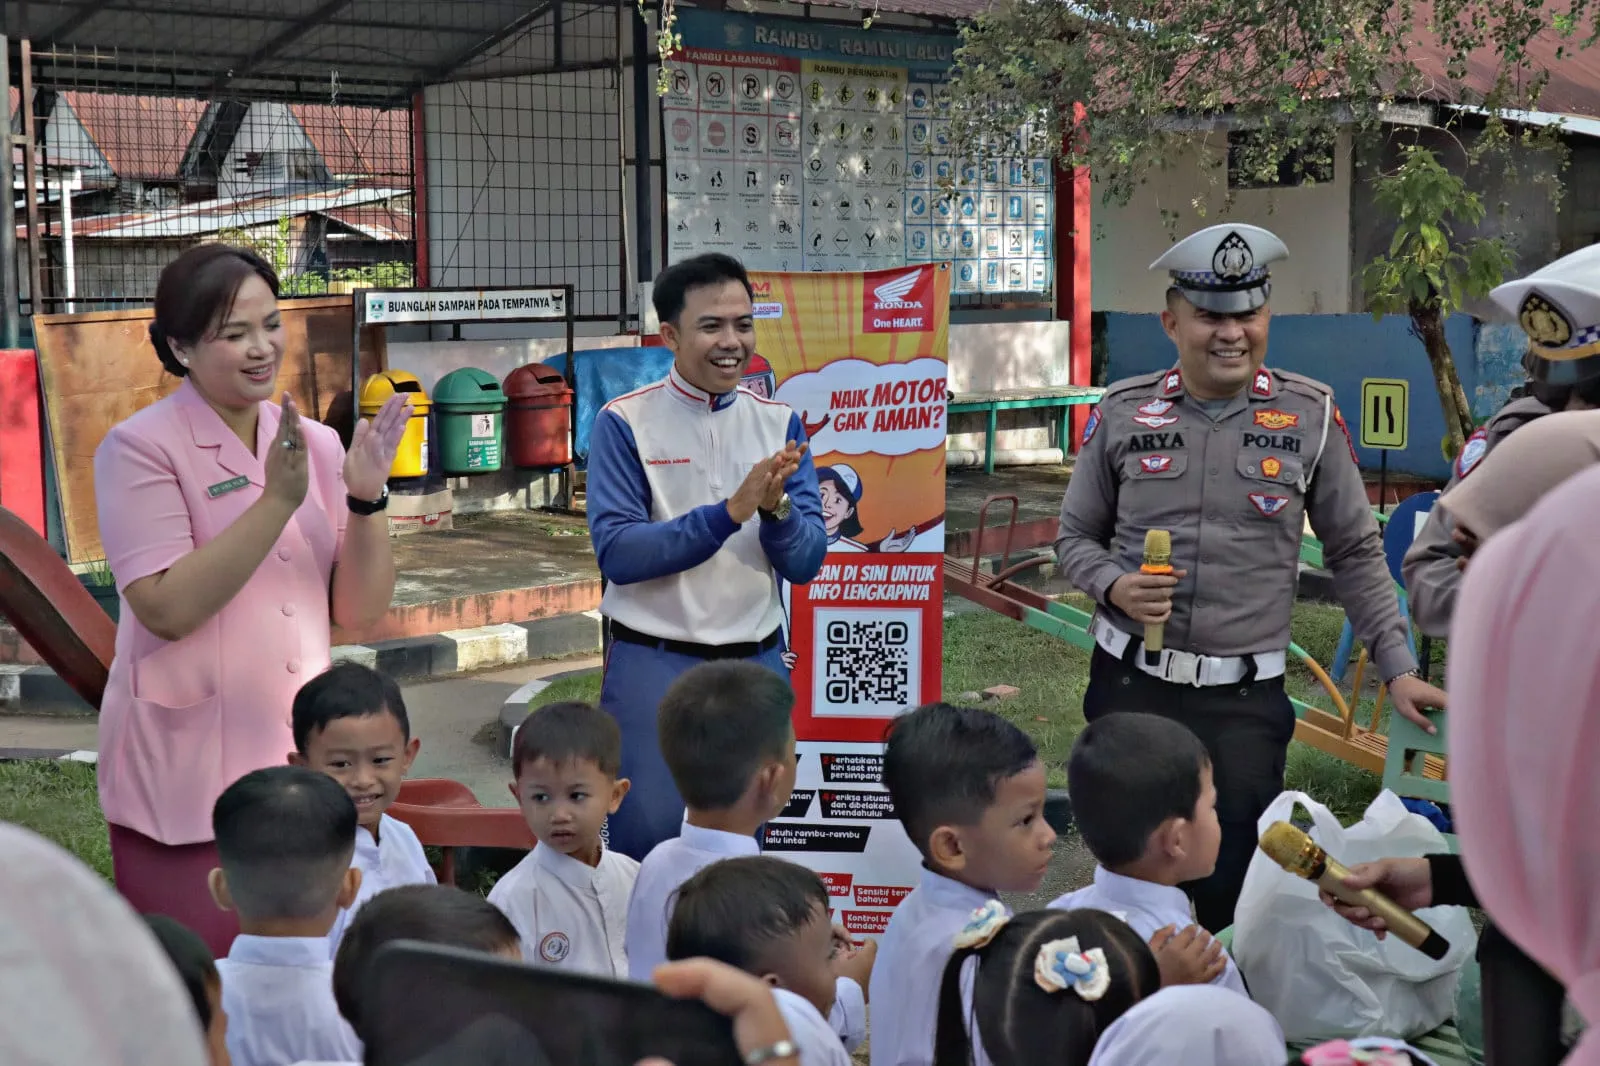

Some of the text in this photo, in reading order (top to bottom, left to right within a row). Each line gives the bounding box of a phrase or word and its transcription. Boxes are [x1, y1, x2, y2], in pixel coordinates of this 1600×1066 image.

[754, 25, 821, 51] RAMBU
[814, 64, 845, 75] RAMBU
[388, 297, 550, 313] BUANGLAH SAMPAH PADA TEMPATNYA
[873, 302, 923, 310] HONDA
[873, 319, 891, 328] One
[830, 378, 947, 410] NAIK MOTOR
[833, 405, 945, 433] GAK AMAN?
[1129, 432, 1185, 450] ARYA
[1243, 432, 1301, 453] POLRI
[842, 565, 859, 581] DI
[860, 565, 888, 582] SINI
[890, 565, 937, 582] UNTUK
[808, 584, 930, 601] INFO LENGKAPNYA
[830, 763, 845, 771] kiri
[862, 794, 890, 802] situasi
[830, 801, 847, 809] dan
[830, 809, 883, 817] mendahului
[794, 830, 860, 838] rambu-rambu
[765, 836, 807, 845] lalu lintas
[857, 887, 889, 896] Sensitif
[856, 896, 889, 904] bahaya
[847, 914, 879, 923] Kontrol
